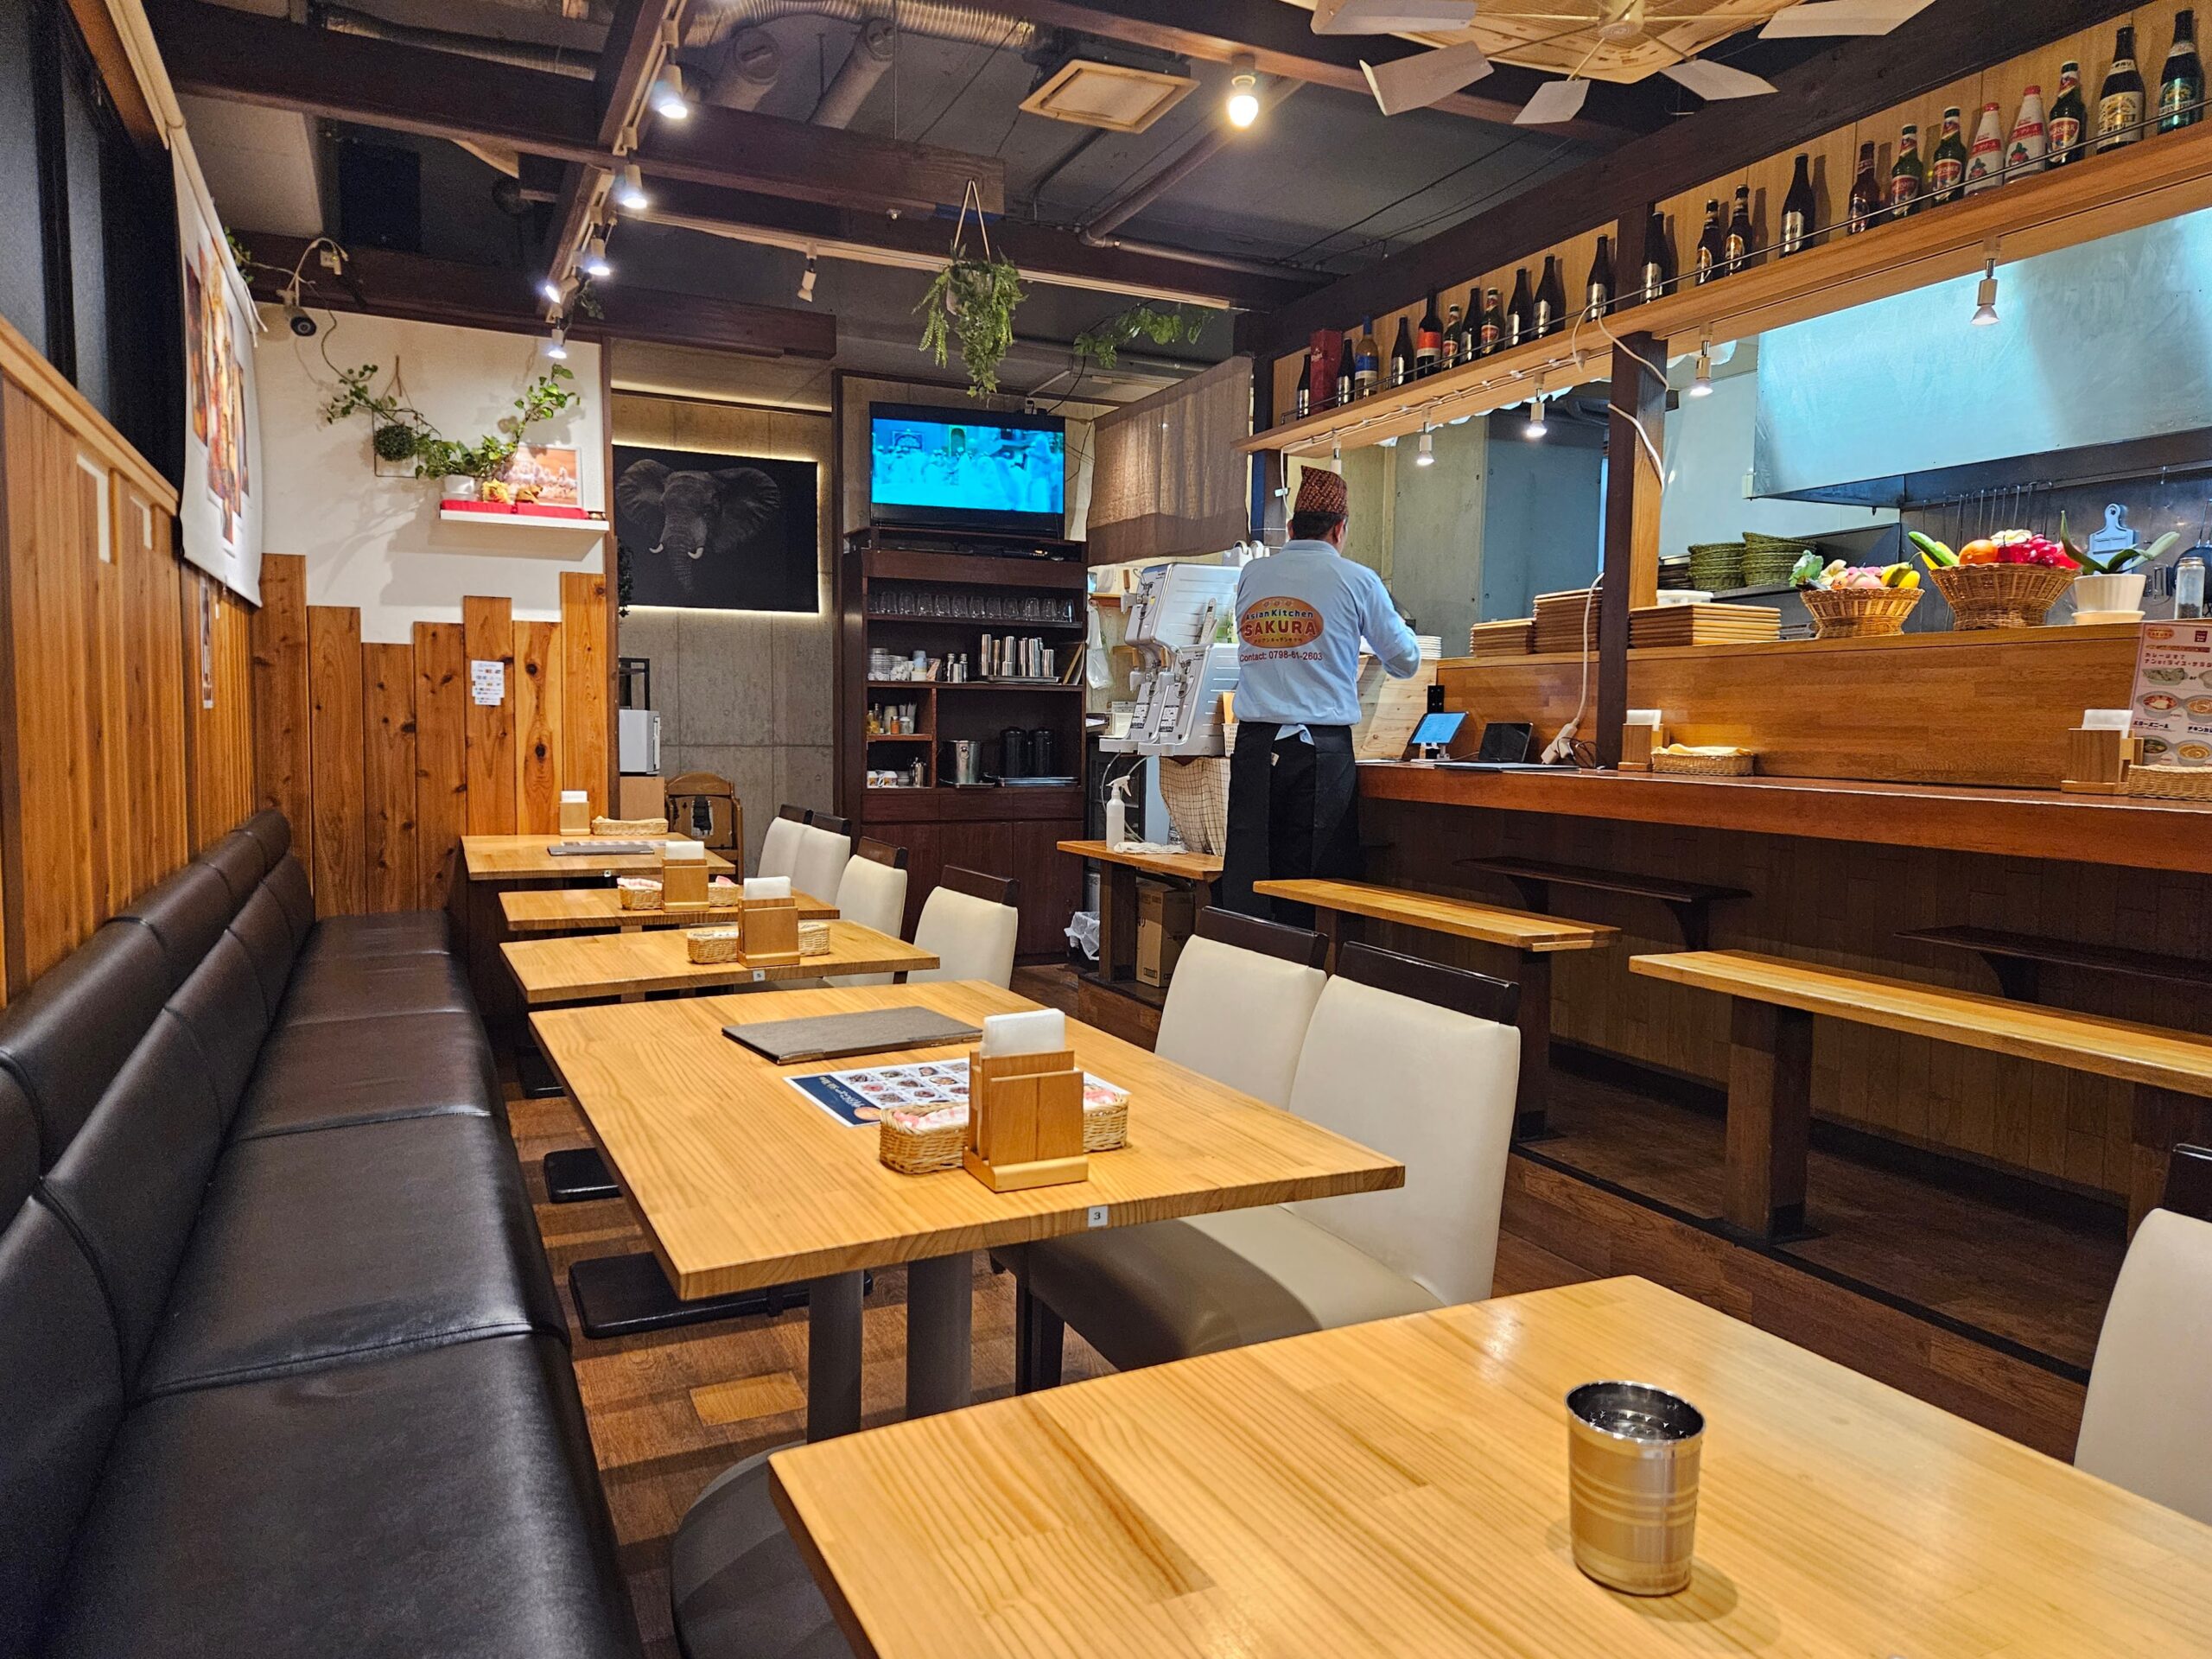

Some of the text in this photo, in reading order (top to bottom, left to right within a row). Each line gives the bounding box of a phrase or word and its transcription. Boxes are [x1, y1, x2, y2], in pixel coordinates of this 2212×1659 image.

[1245, 609, 1313, 620] Asian Kitchen
[1244, 620, 1316, 637] SAKURA
[1239, 652, 1268, 663] Contact:
[1093, 1211, 1101, 1220] 3
